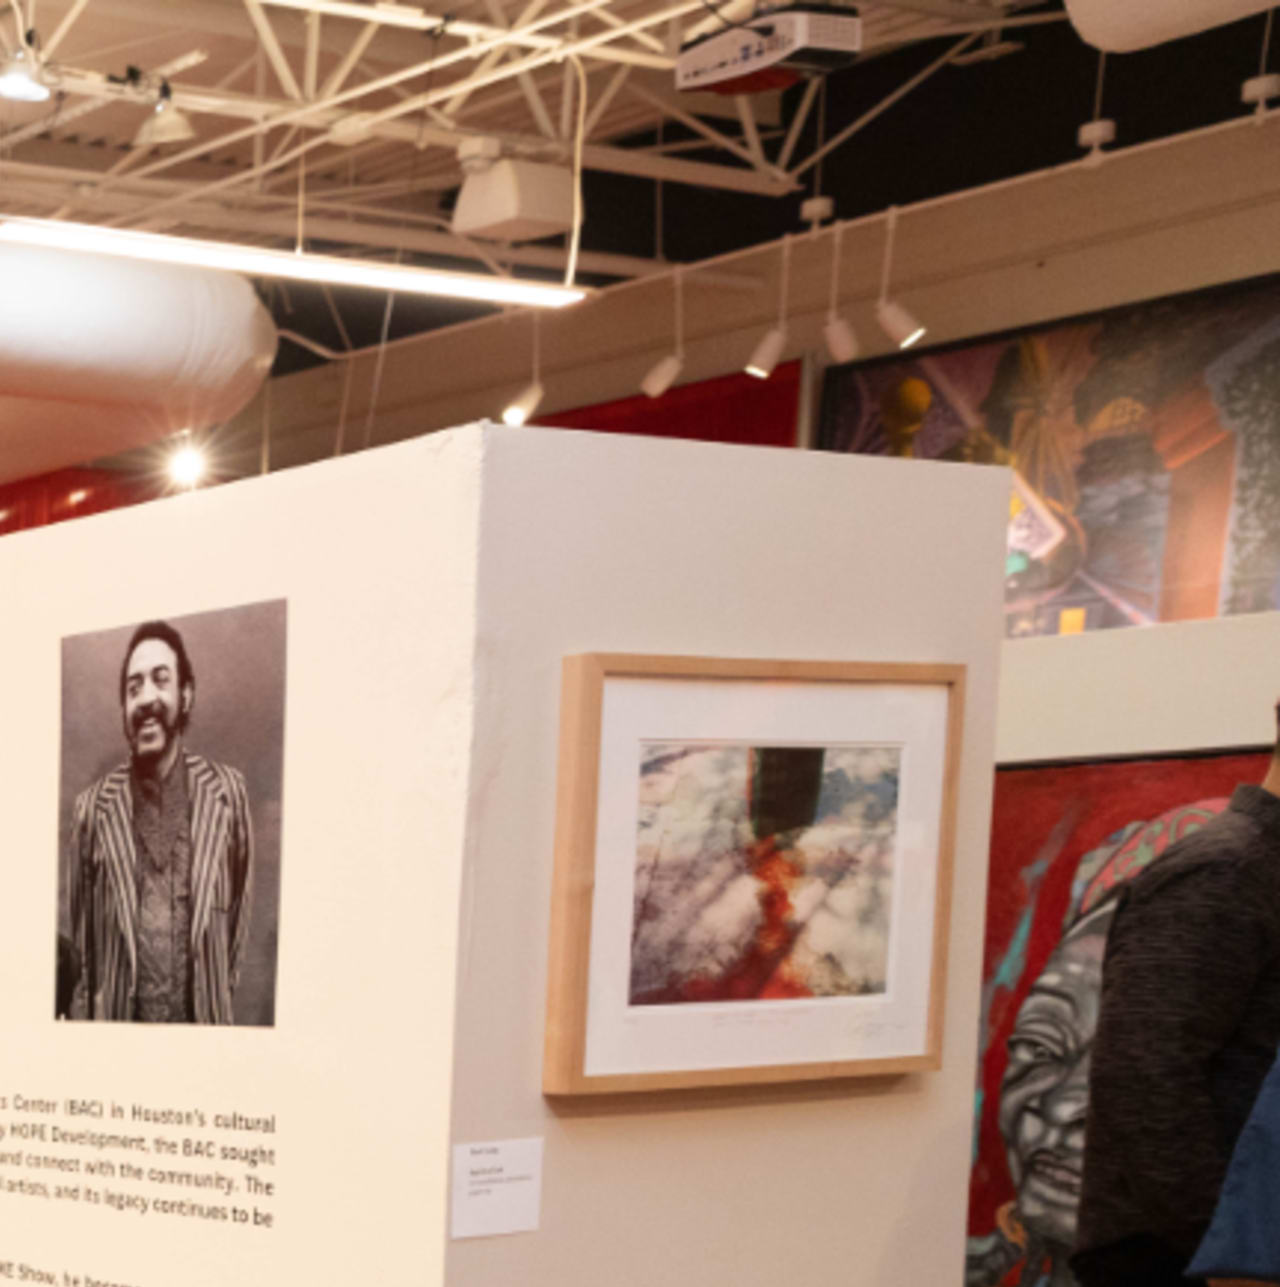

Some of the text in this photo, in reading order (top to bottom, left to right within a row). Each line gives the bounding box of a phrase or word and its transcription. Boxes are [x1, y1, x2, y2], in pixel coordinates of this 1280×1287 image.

[65, 1099, 104, 1118] (BAC)
[111, 1102, 124, 1119] in
[131, 1104, 205, 1128] Houston's
[214, 1112, 276, 1134] cultural
[51, 1125, 150, 1152] Development,
[153, 1137, 178, 1155] the
[182, 1138, 214, 1158] BAC
[220, 1146, 275, 1168] sought
[85, 1160, 115, 1177] with
[119, 1163, 143, 1181] the
[148, 1168, 238, 1196] community.
[246, 1174, 274, 1196] The
[54, 1186, 80, 1201] and
[84, 1187, 100, 1204] its
[104, 1189, 149, 1215] legacy
[152, 1198, 227, 1221] continues
[232, 1206, 248, 1223] to
[253, 1207, 273, 1228] be
